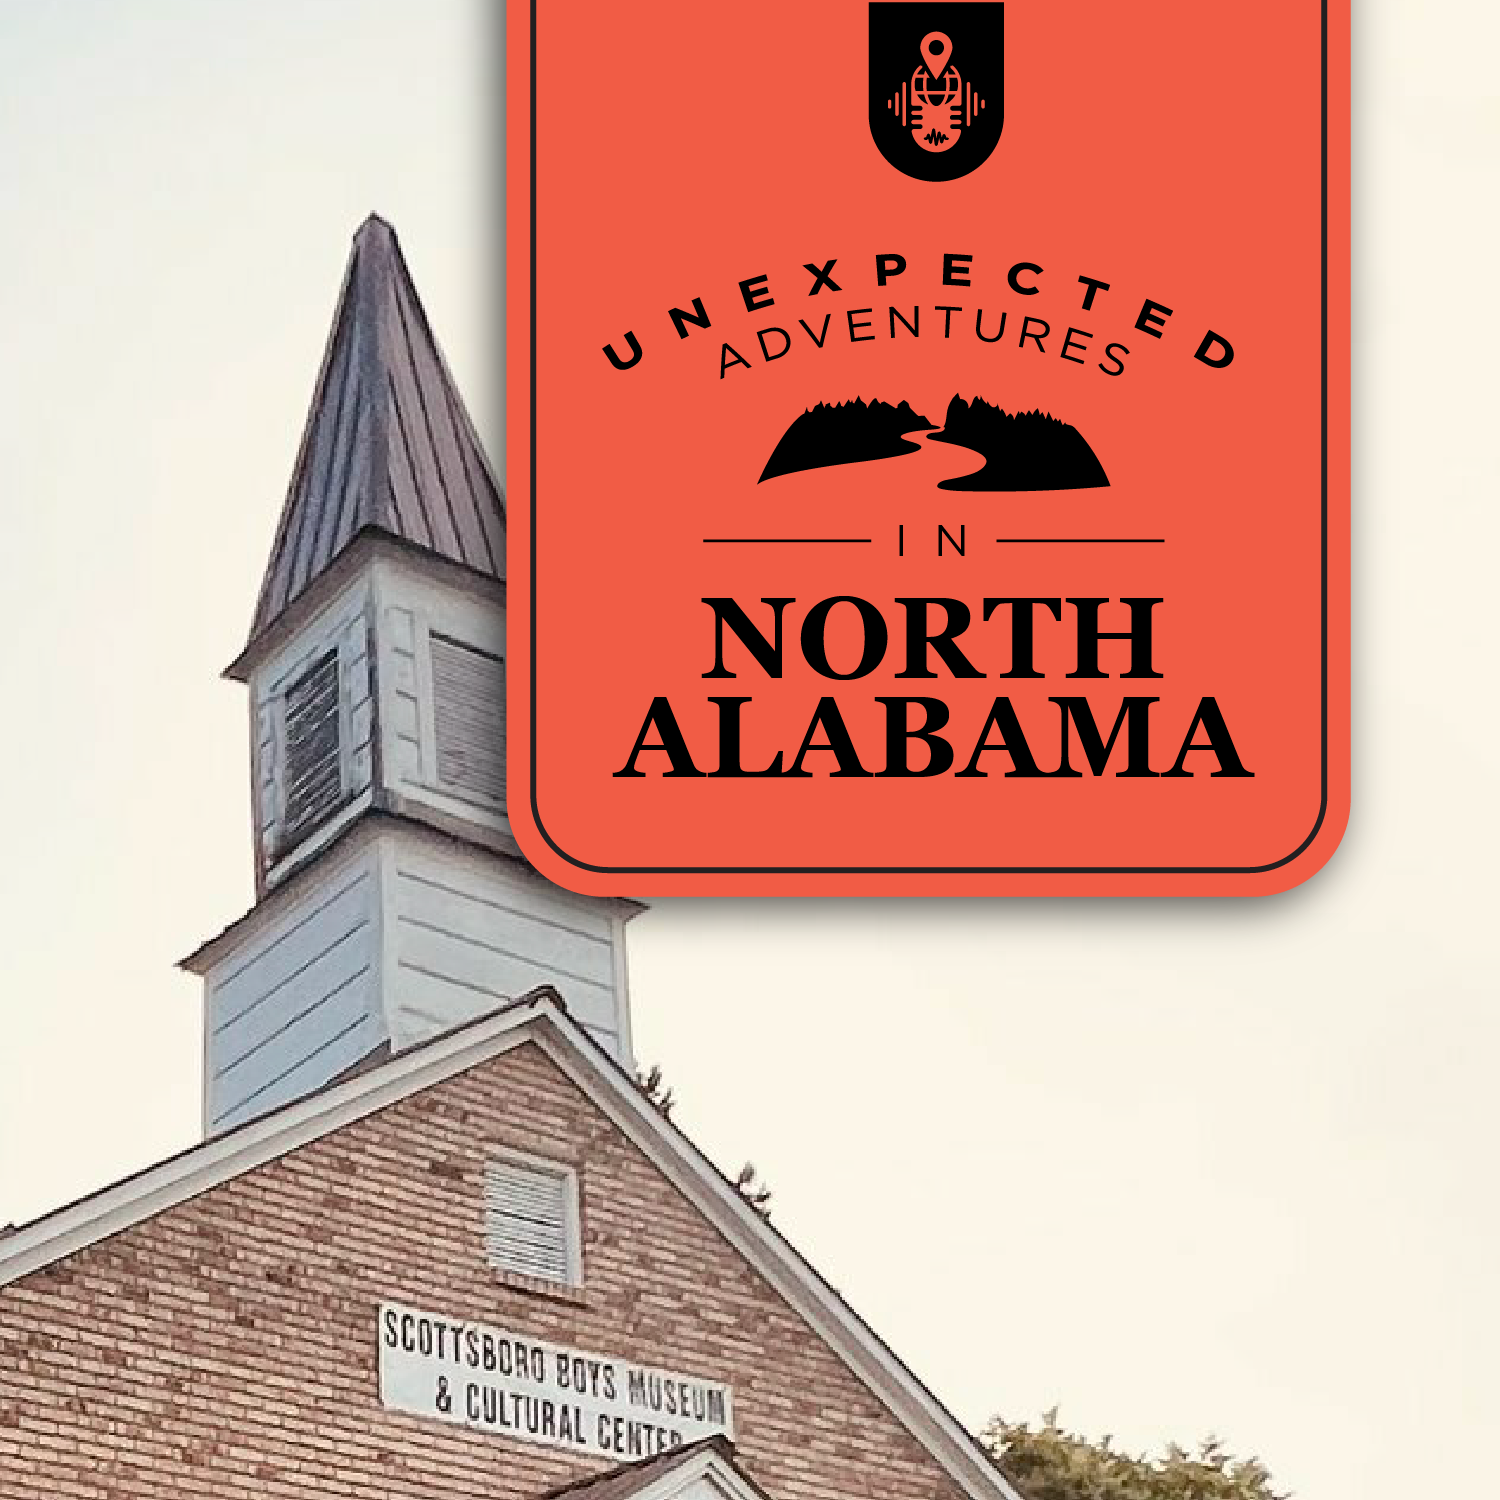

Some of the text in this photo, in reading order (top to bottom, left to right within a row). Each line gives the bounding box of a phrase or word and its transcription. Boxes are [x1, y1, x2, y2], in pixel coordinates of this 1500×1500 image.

[384, 1308, 727, 1425] SCOTTSBORO BOYS MUSEUM
[435, 1375, 453, 1414] &
[465, 1382, 588, 1445] CULTURAL
